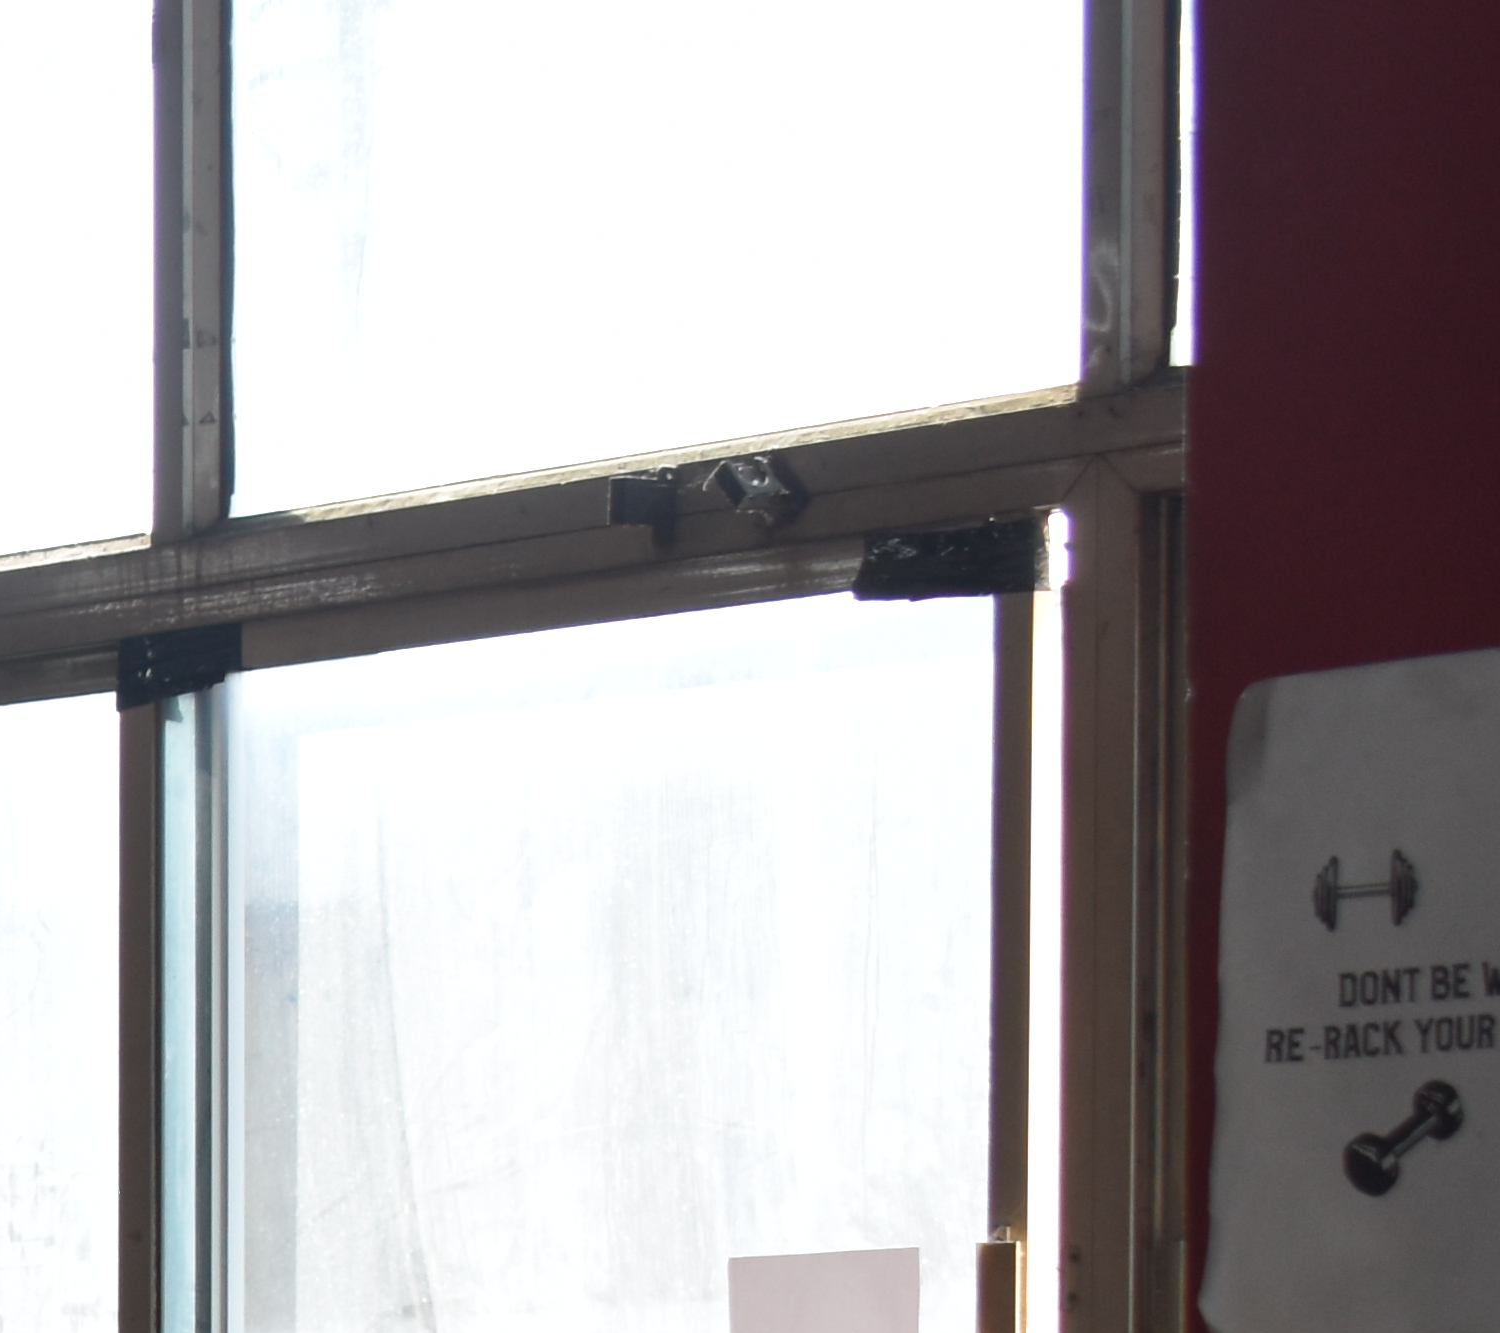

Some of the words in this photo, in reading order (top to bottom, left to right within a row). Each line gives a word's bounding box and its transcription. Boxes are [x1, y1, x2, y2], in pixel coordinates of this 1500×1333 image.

[1338, 968, 1421, 1008] DONT
[1430, 963, 1471, 1002] BE
[1414, 1014, 1496, 1054] YOUR
